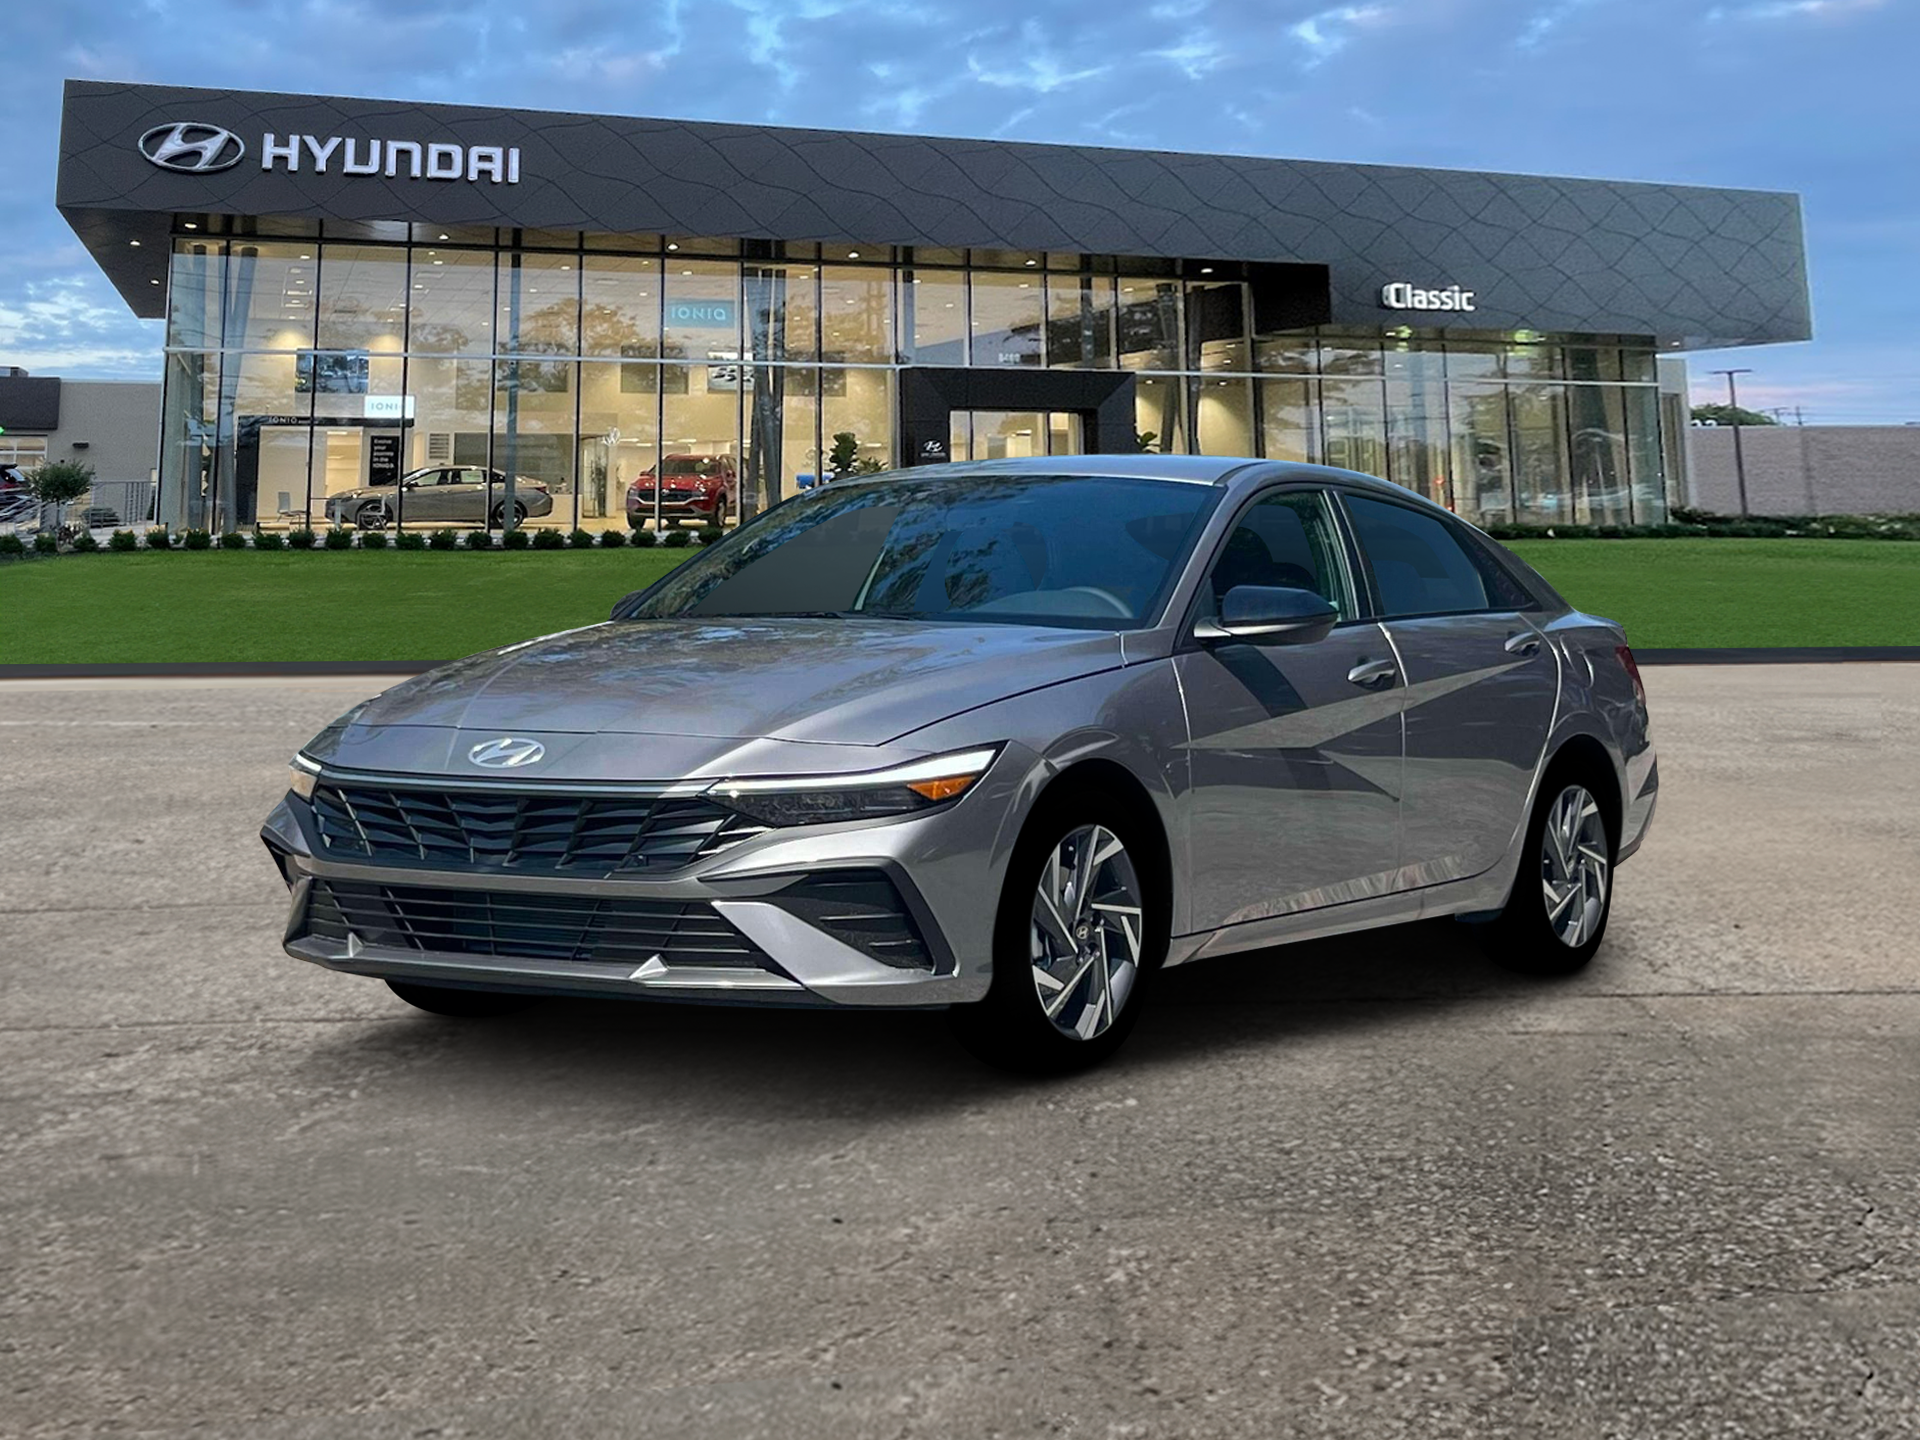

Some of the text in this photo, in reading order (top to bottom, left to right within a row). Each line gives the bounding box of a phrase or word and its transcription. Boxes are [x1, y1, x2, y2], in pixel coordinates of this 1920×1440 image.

[261, 132, 520, 184] HYUNDAI
[1382, 282, 1476, 312] Classic
[671, 306, 726, 321] IONIQ
[371, 402, 403, 411] IONI
